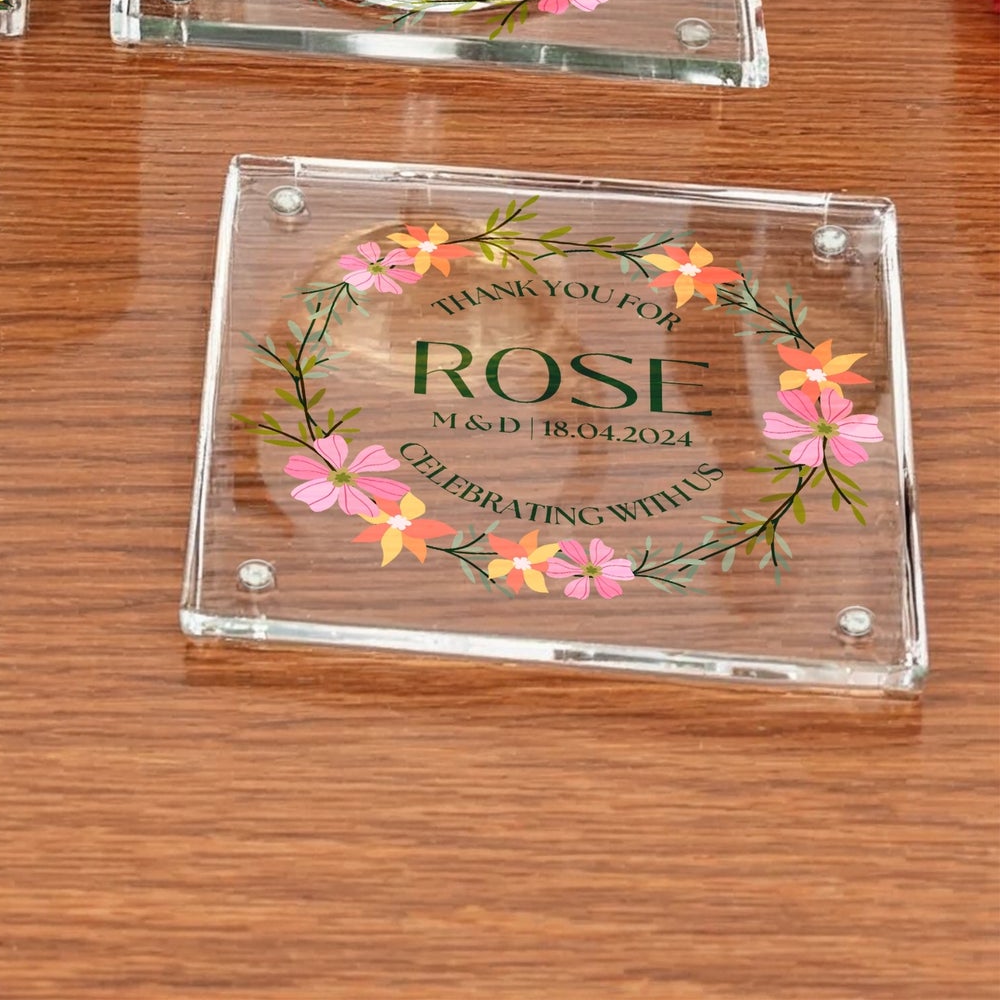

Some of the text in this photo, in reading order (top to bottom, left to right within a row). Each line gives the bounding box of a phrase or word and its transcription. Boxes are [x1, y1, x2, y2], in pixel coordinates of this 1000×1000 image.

[431, 279, 682, 332] THANK YOU FOR
[413, 340, 712, 417] ROSE
[400, 442, 724, 526] CELEBRATING WITH US
